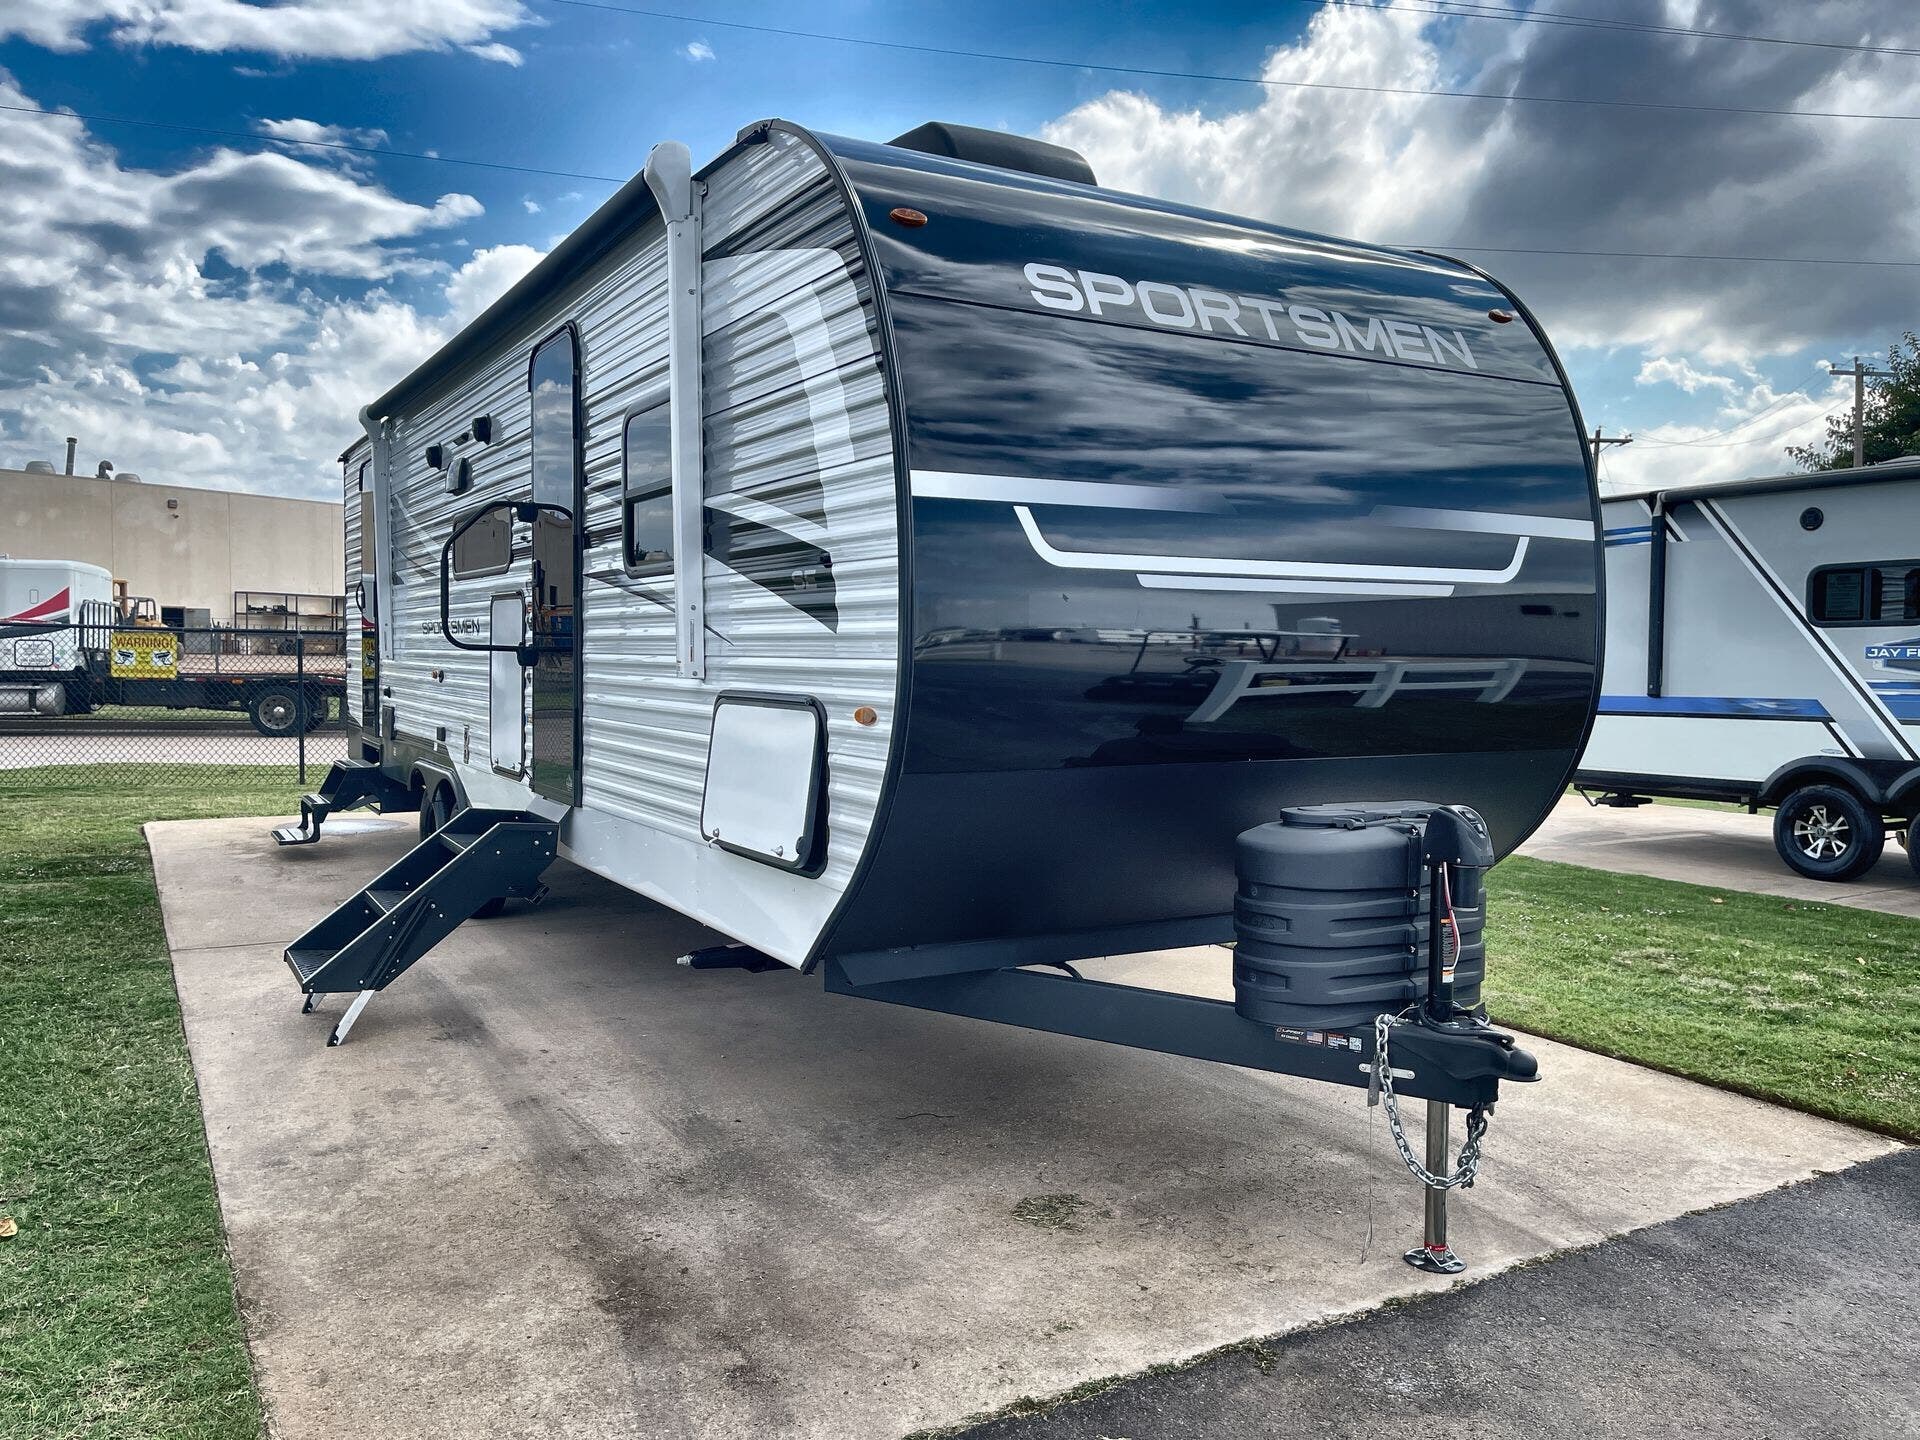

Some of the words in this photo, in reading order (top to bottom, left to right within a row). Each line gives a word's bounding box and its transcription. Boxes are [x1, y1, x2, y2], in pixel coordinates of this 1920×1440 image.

[1023, 262, 1479, 369] SPORTSMEN
[421, 618, 480, 635] SPORSMEN
[115, 636, 174, 648] WARNING!
[1867, 648, 1901, 658] JAY
